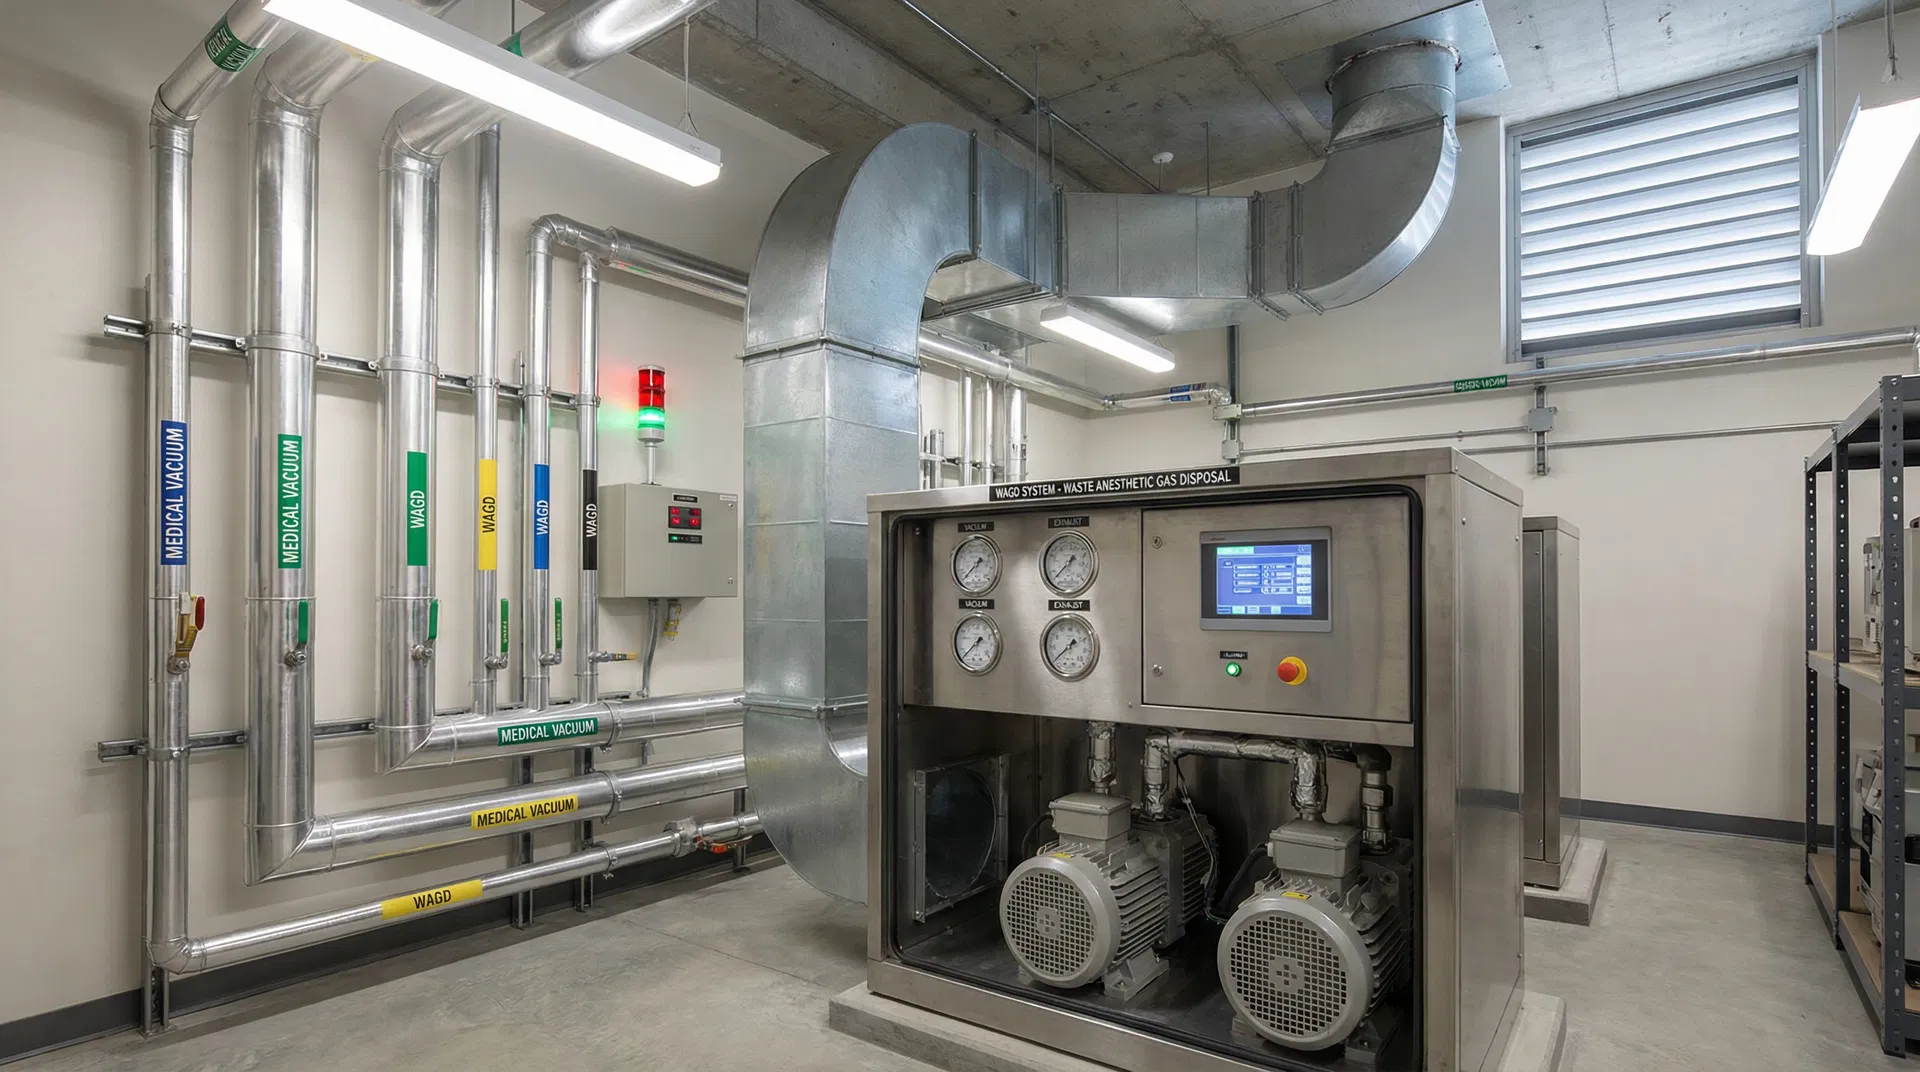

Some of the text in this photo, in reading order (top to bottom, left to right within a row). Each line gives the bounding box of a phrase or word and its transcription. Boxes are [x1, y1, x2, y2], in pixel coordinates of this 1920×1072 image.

[165, 428, 184, 559] MEDICAL VACUUM
[1021, 484, 1056, 497] SYSTEM
[1063, 482, 1094, 494] WASTE
[1096, 476, 1154, 491] ANESTHETIC
[1156, 475, 1177, 487] GAS
[1179, 470, 1232, 485] DISPOSAL
[282, 440, 300, 563] MEDICAL VACUUM
[410, 490, 425, 529] WAGD
[482, 496, 496, 534] WAGD
[536, 500, 549, 536] WAGD
[585, 503, 598, 538] WAGD
[501, 720, 595, 743] MEDICAL VACUUM
[477, 798, 574, 827] MEDICAL VACUUM
[413, 889, 452, 909] WAGD
